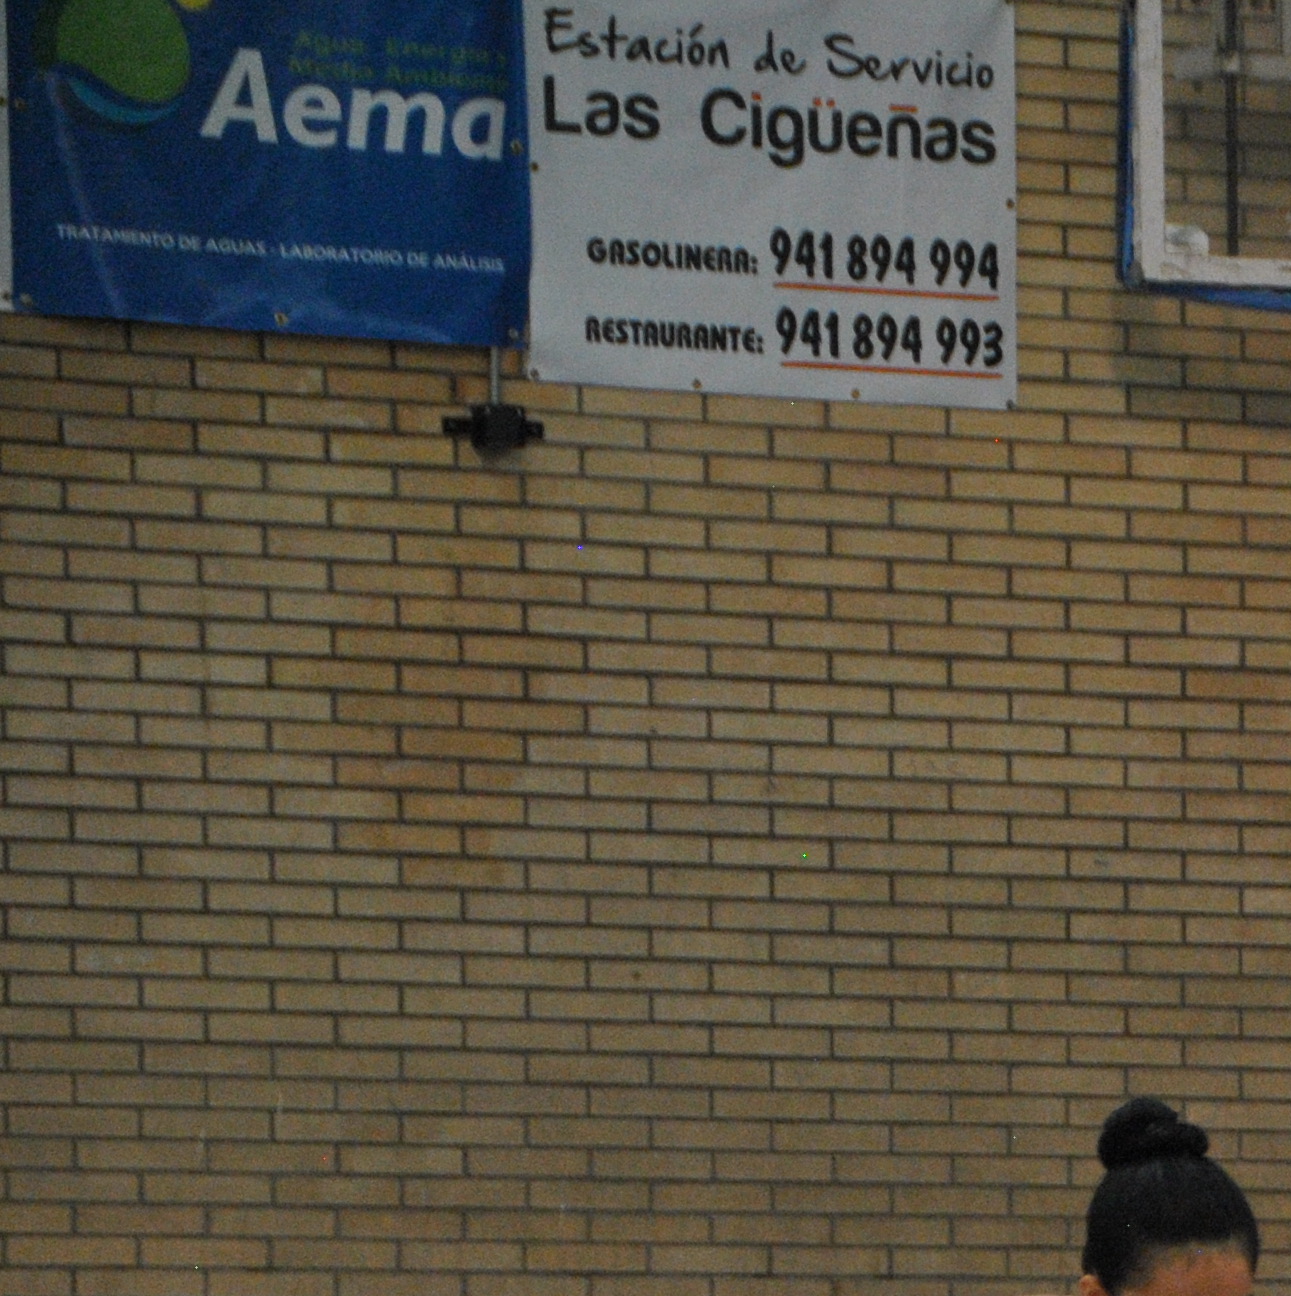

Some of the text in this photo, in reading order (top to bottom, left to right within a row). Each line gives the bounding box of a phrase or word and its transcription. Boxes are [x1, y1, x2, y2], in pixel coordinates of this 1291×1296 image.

[544, 8, 995, 91] Estación de Servicio
[200, 48, 506, 160] Aema
[543, 75, 997, 168] Las Cigüeñas
[57, 223, 174, 249] TRATAMIENTO
[179, 233, 200, 252] DE
[205, 237, 265, 256] AGUAS
[279, 243, 402, 266] LABORATORIO
[407, 252, 429, 268] DE
[587, 226, 999, 290] GASOLINERA: 941 894 994
[585, 306, 1004, 367] RESTAURANTE: 941 894 993
